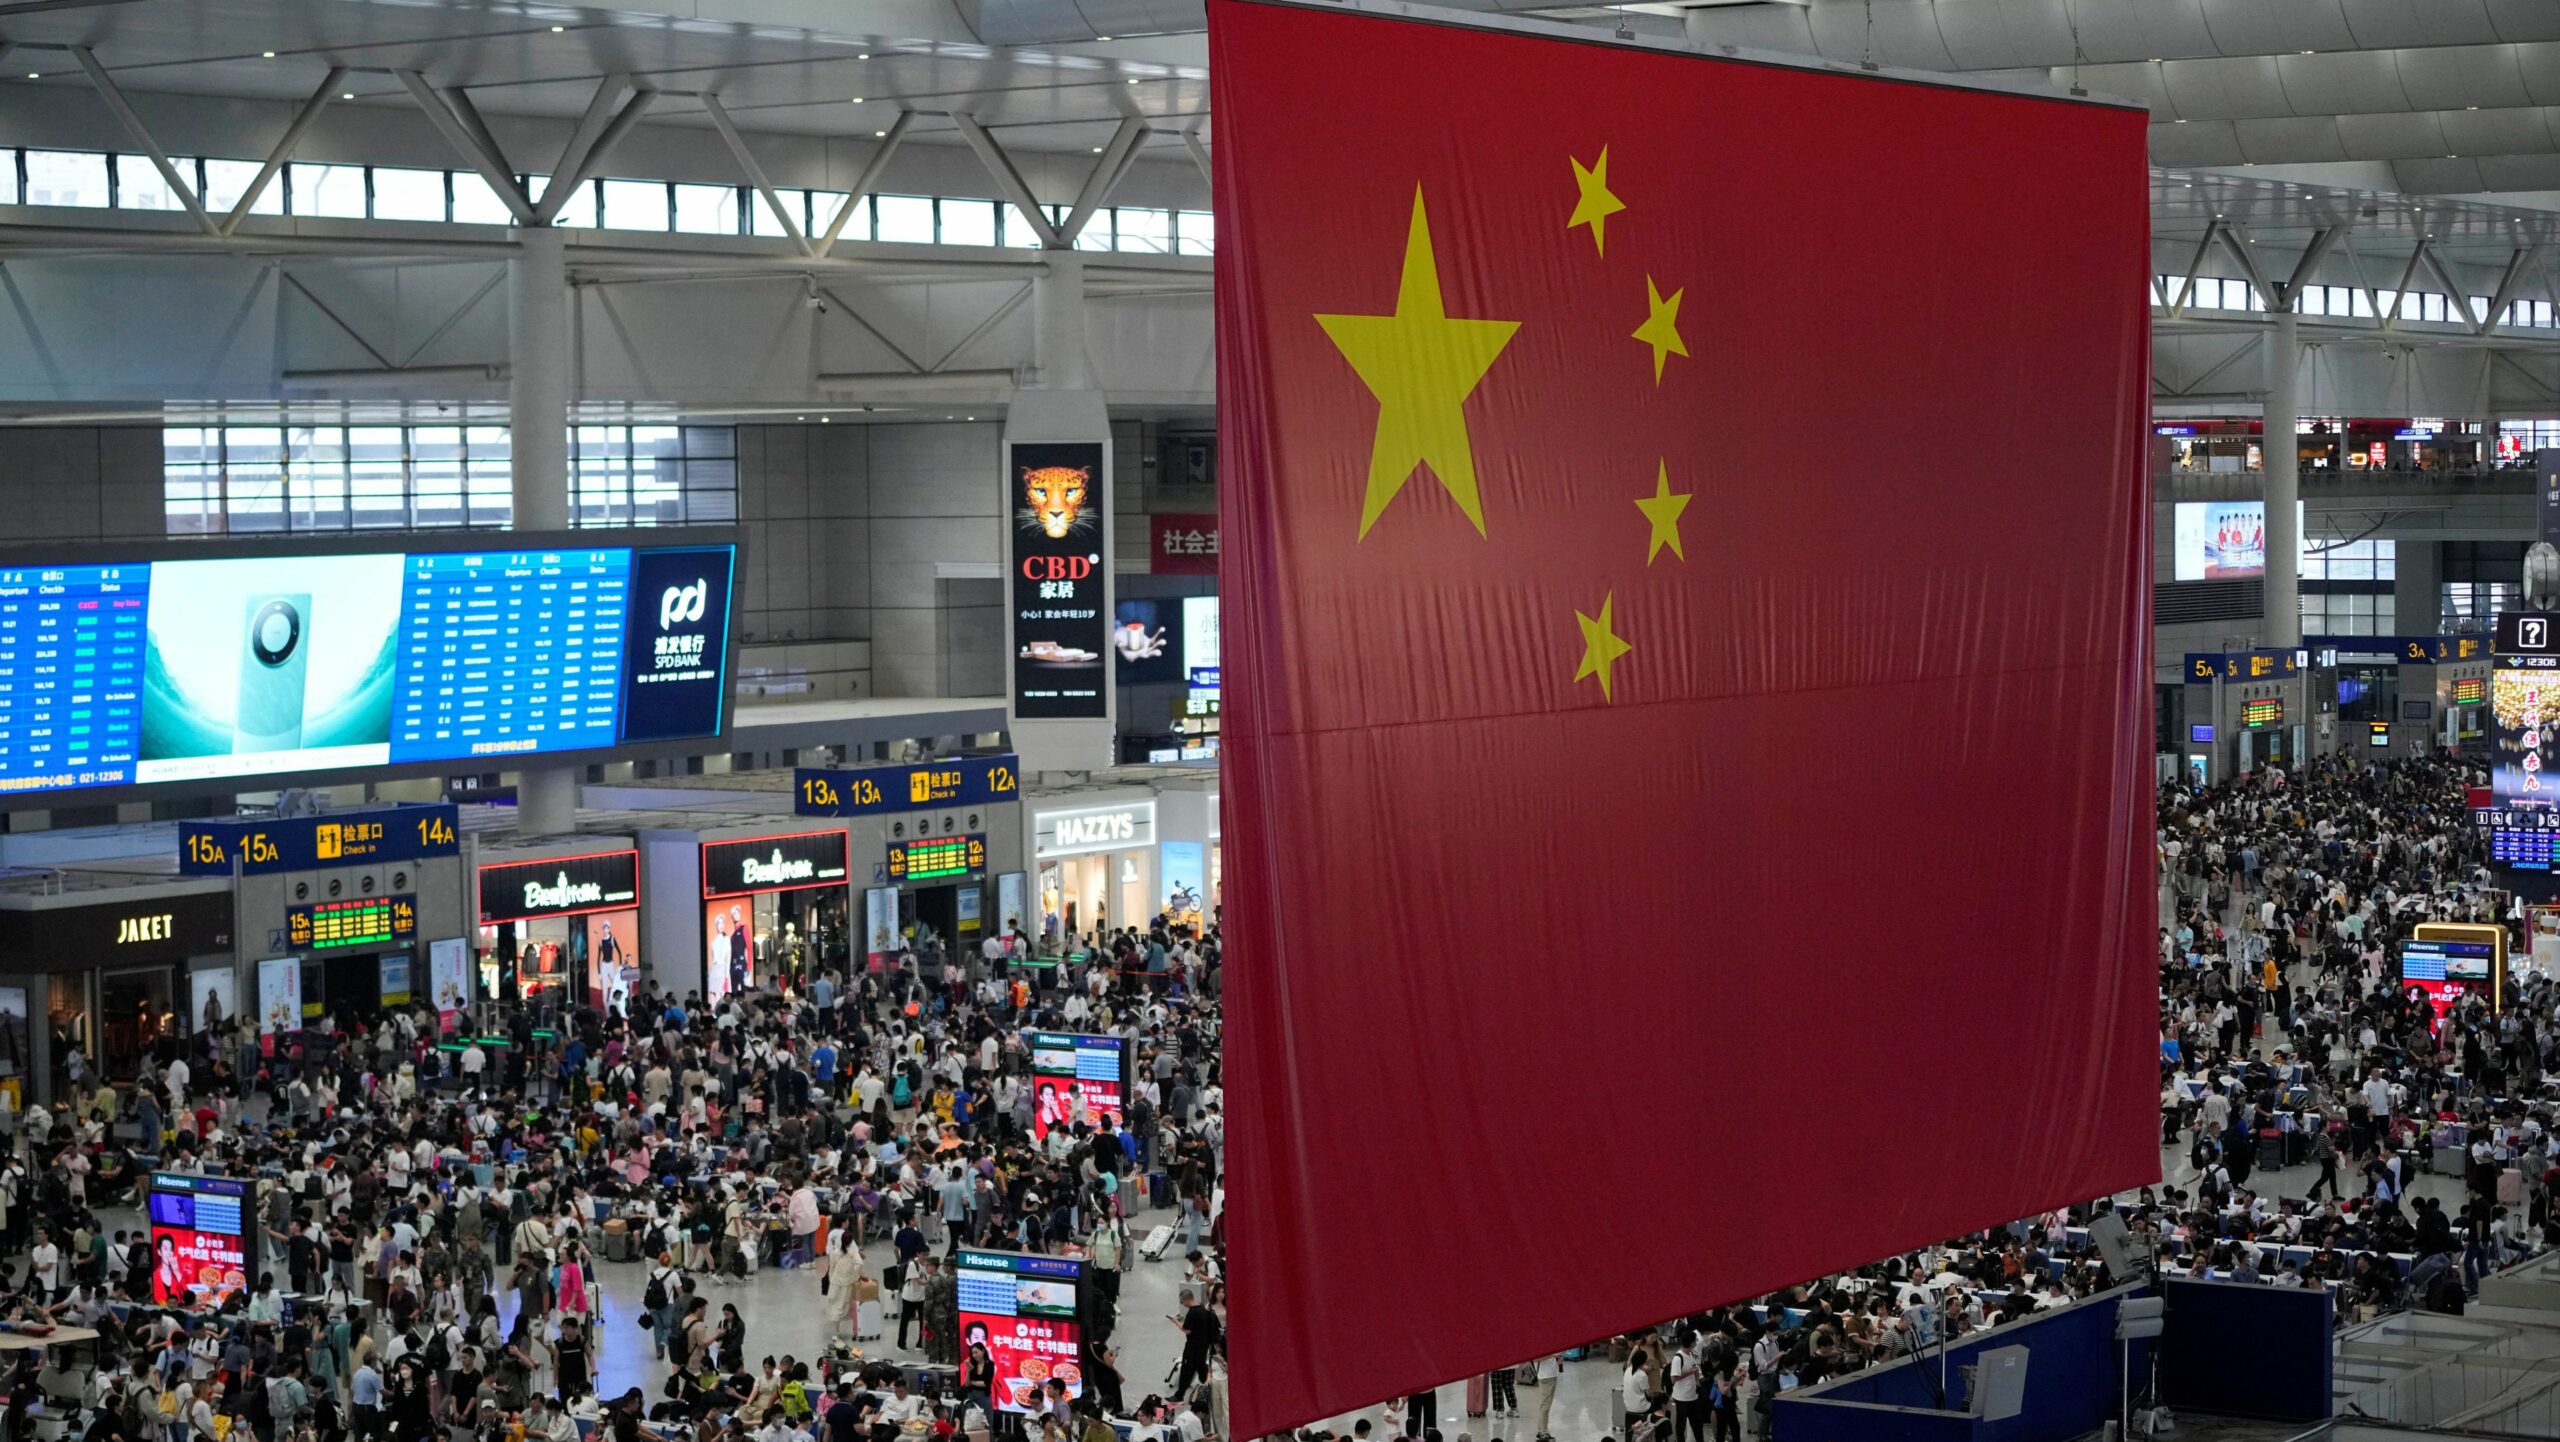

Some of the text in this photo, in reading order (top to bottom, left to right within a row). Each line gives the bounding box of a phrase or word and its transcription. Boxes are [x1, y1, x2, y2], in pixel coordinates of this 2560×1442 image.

[1164, 529, 1218, 554] 社会主
[1023, 556, 1091, 580] CBD
[1040, 581, 1074, 599] 家居
[2408, 642, 2426, 658] 3A
[655, 654, 702, 669] SPD BANK
[2195, 660, 2214, 677] 5A
[2228, 660, 2238, 676] 5A
[2285, 655, 2295, 671] 4A
[2527, 658, 2556, 666] 12306
[79, 770, 124, 784] 021-12306
[803, 779, 839, 805] 13A
[851, 767, 1016, 805] 13A 检票口 12A
[931, 790, 949, 799] Check
[1056, 812, 1134, 846] HAZZYS
[239, 817, 454, 863] 15A 检票口 14A
[187, 834, 226, 864] 15A
[343, 844, 367, 855] Check
[290, 901, 413, 929] 15A 14A
[117, 914, 173, 944] JAKET
[2409, 943, 2439, 951] Hisense
[1039, 1035, 1071, 1045] Hisense
[157, 1176, 191, 1188] Hisense
[966, 1254, 1009, 1268] Hisense
[1029, 1327, 1053, 1338] 必胜客
[993, 1335, 1034, 1351] 牛气必胜
